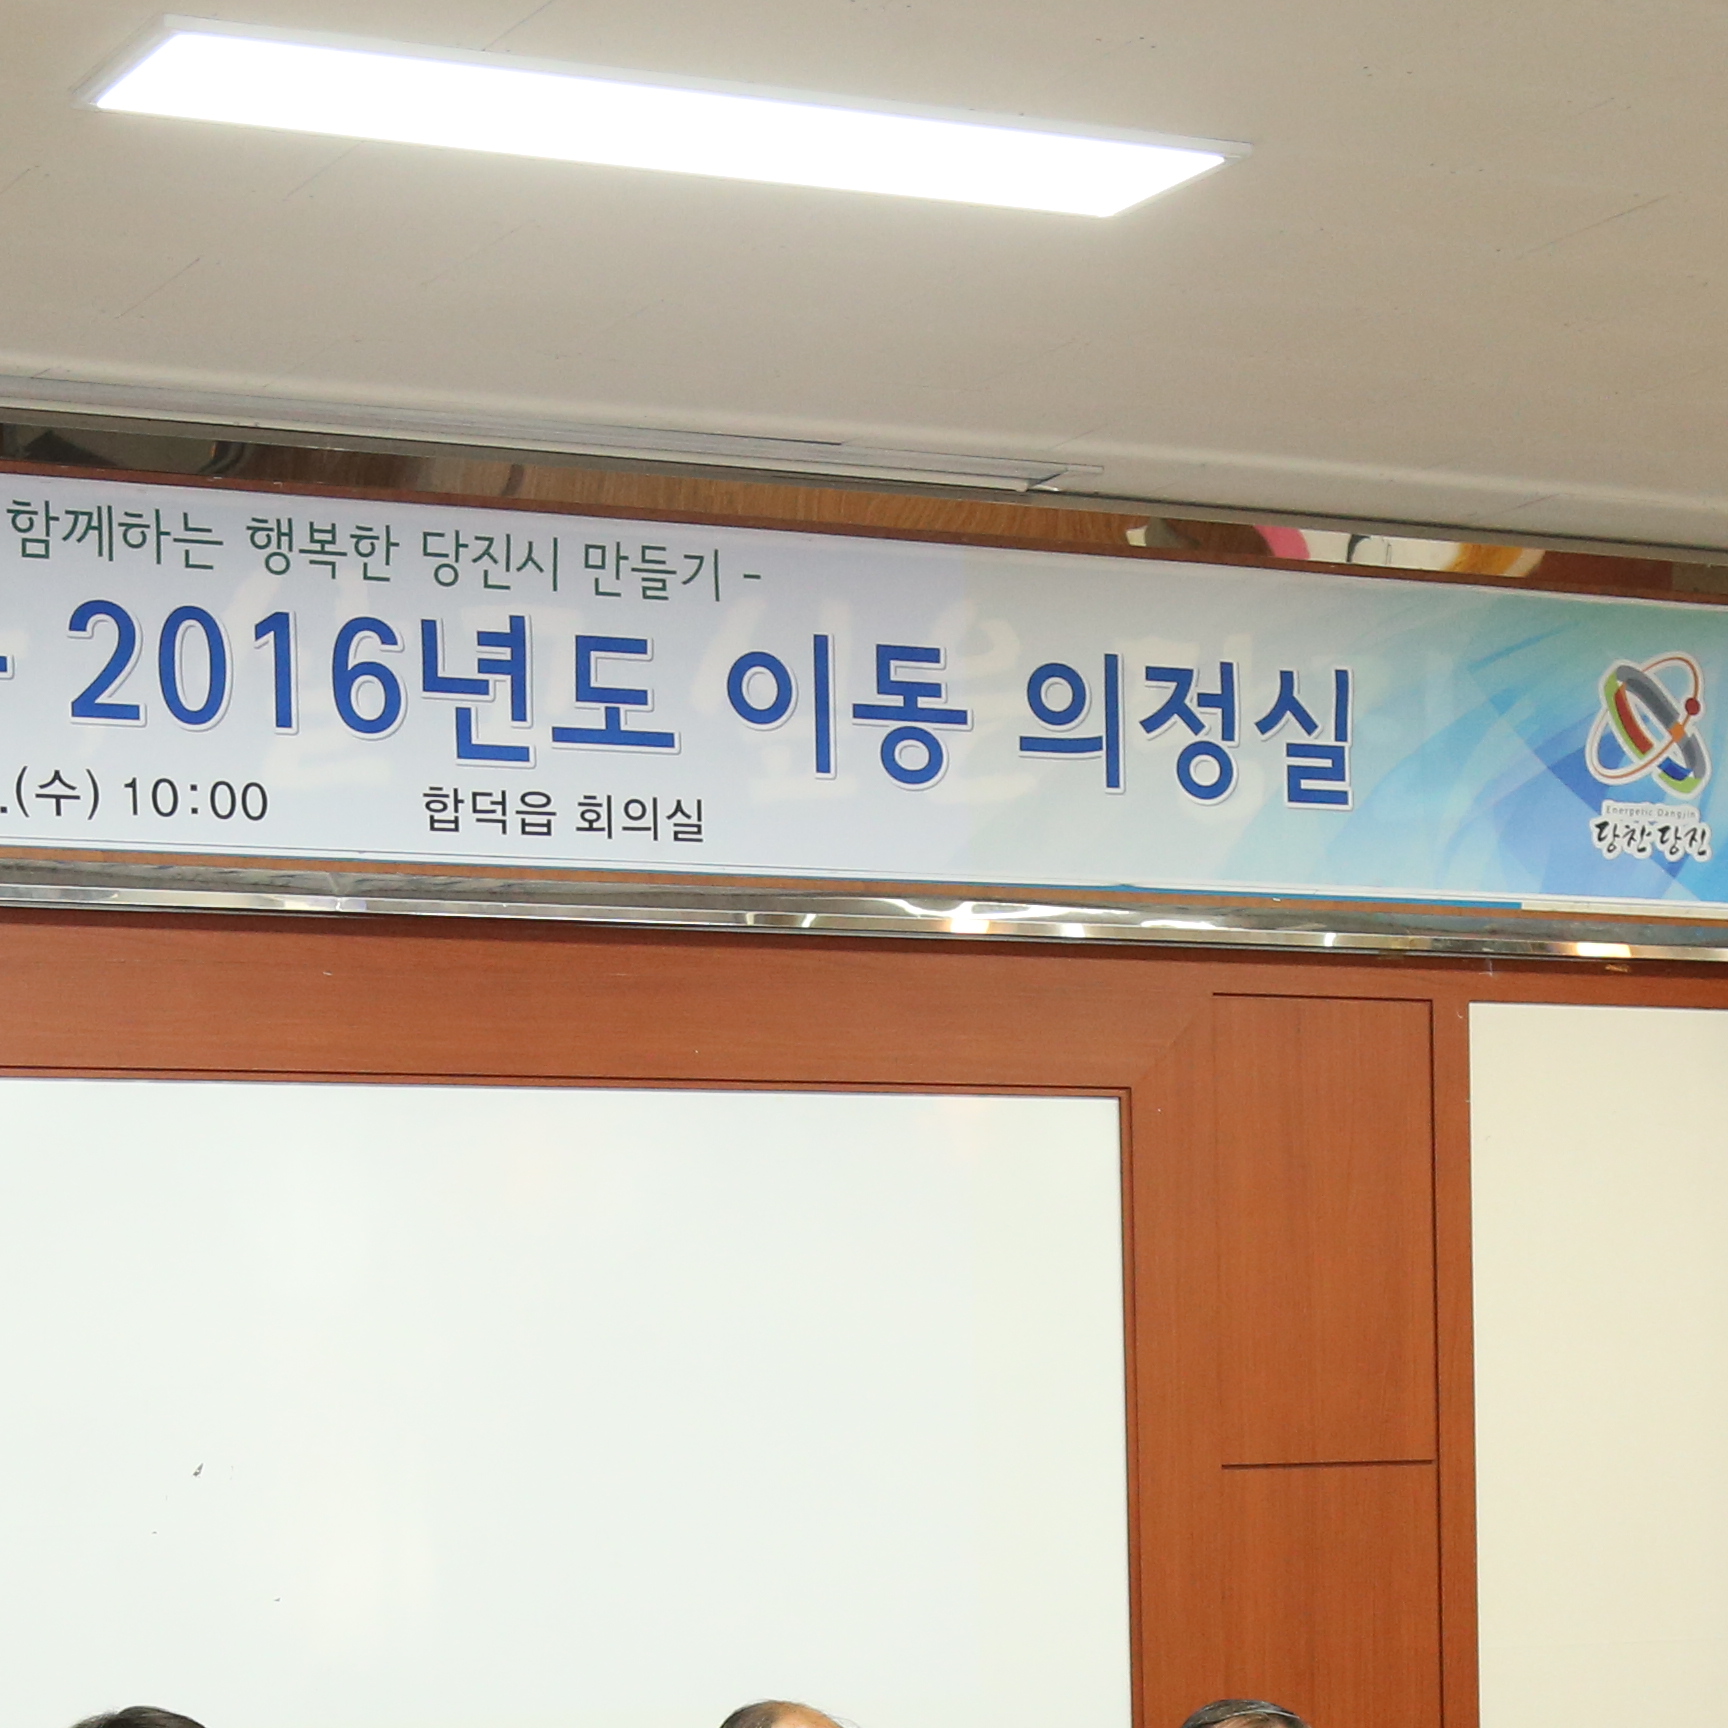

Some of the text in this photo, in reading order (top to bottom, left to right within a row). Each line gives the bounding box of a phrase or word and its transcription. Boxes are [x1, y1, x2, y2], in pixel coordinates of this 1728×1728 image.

[5, 499, 225, 571] 함께하는
[244, 516, 401, 584] 행복한
[421, 528, 560, 592] 당진시
[583, 541, 721, 602] 만들기
[69, 600, 676, 763] 2016년도
[727, 635, 968, 785] 이동
[1019, 654, 1354, 806] 의정실
[122, 776, 269, 823] 10:00
[421, 786, 706, 844] 합덕읍 회의실
[1657, 808, 1697, 819] Dangjin
